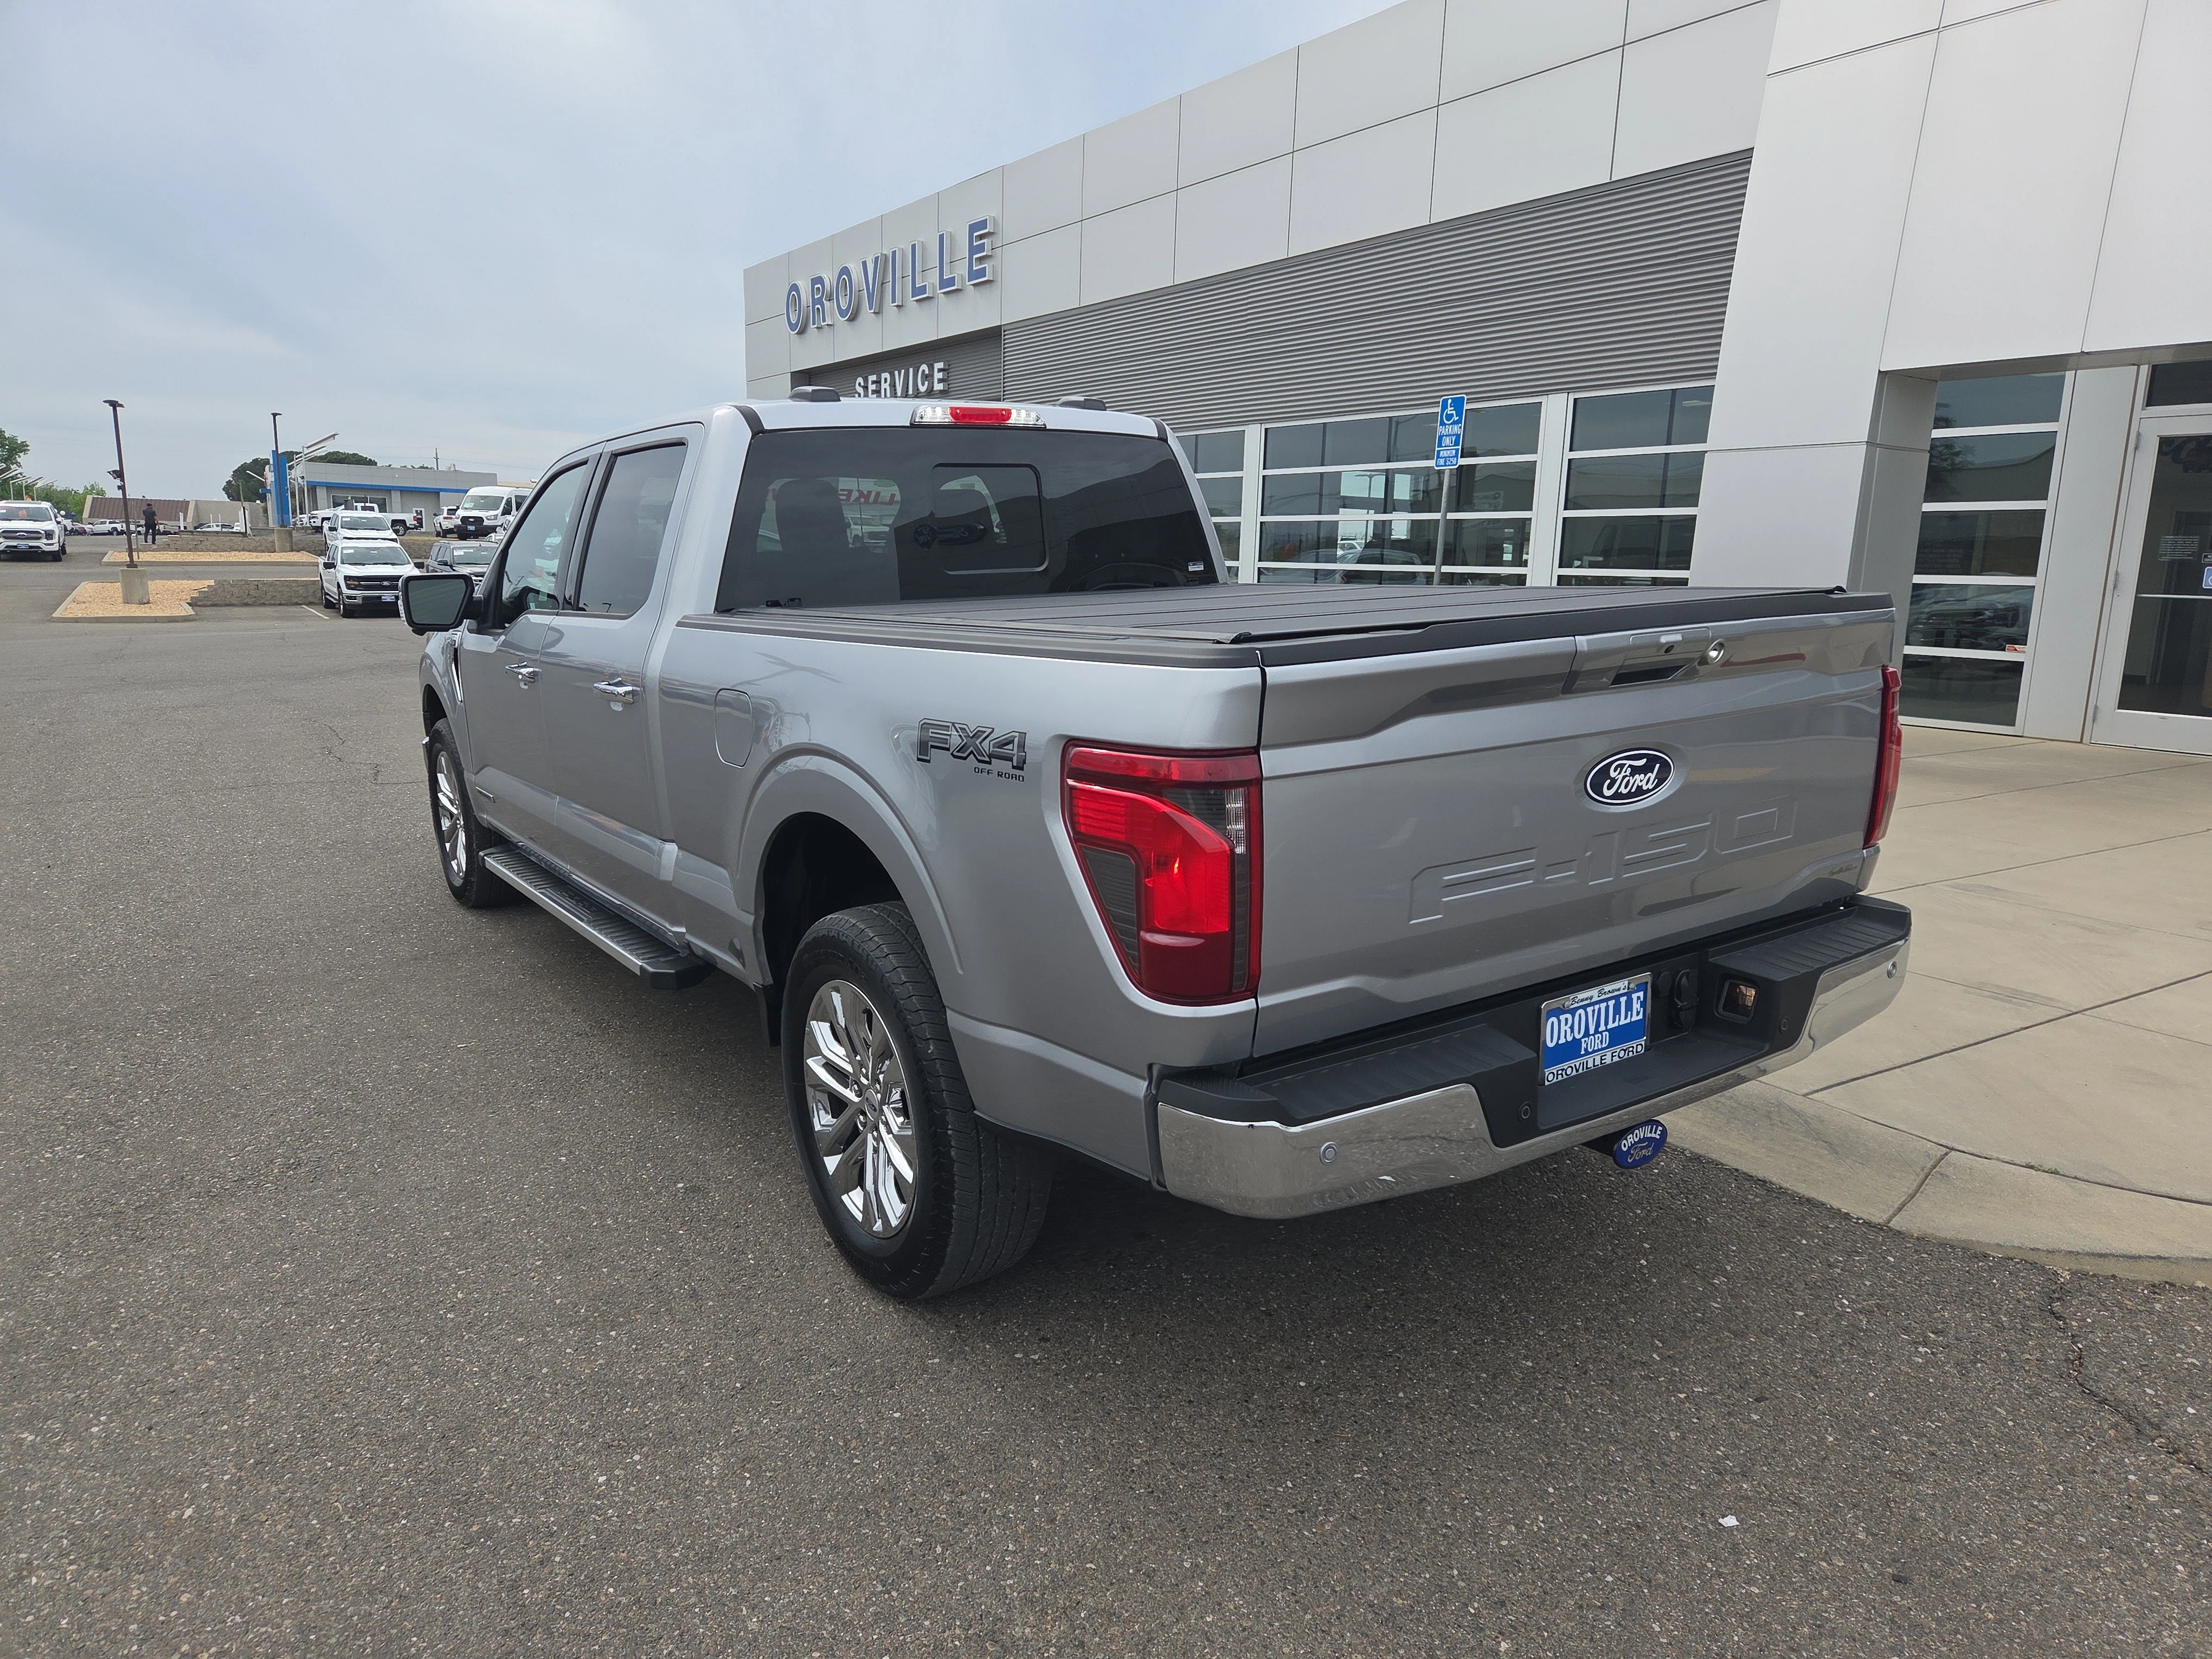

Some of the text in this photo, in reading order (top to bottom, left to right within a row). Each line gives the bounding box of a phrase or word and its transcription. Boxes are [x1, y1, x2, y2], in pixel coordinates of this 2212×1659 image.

[785, 215, 995, 335] OROVILLE
[854, 362, 944, 398] SERVICE
[1438, 423, 1462, 435] PARKING
[1442, 436, 1456, 446] ONLY
[917, 717, 1027, 771] FX4
[974, 767, 1024, 782] OFF ROAD
[1603, 758, 1660, 796] Ford
[1409, 795, 1797, 924] F-150
[1570, 982, 1627, 1006] Benny Brown's
[1546, 991, 1644, 1047] OROVILLE
[1580, 1031, 1609, 1054] FORD
[1546, 1043, 1644, 1083] OROVILLE FORD
[1621, 1125, 1663, 1152] OROVILLE
[1628, 1142, 1655, 1163] Ford
